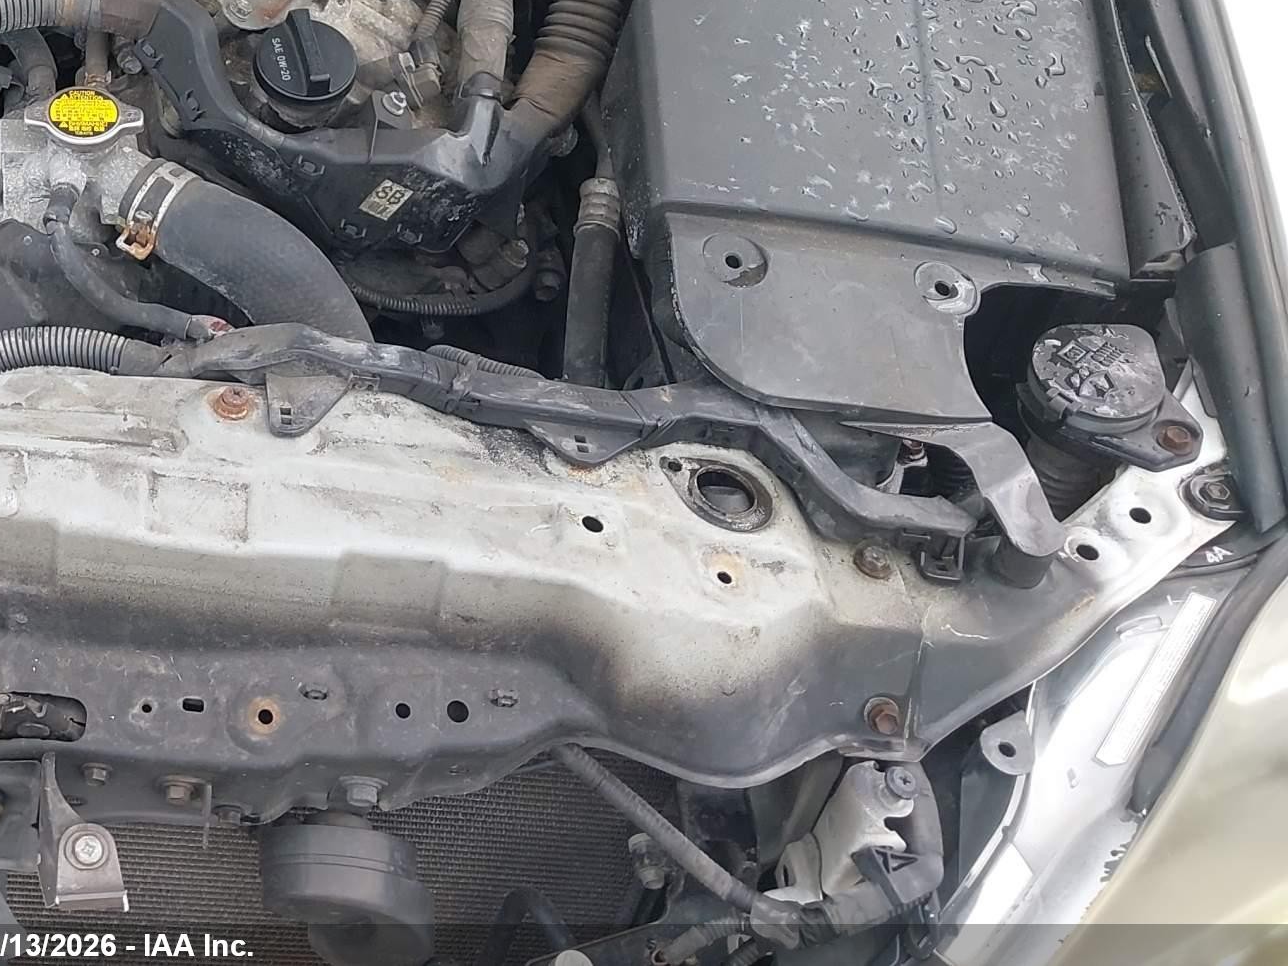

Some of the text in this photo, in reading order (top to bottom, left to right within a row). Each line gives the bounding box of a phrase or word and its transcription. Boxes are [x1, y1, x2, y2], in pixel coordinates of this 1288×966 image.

[272, 37, 292, 81] SAE 0W-20
[1205, 546, 1233, 563] 4A
